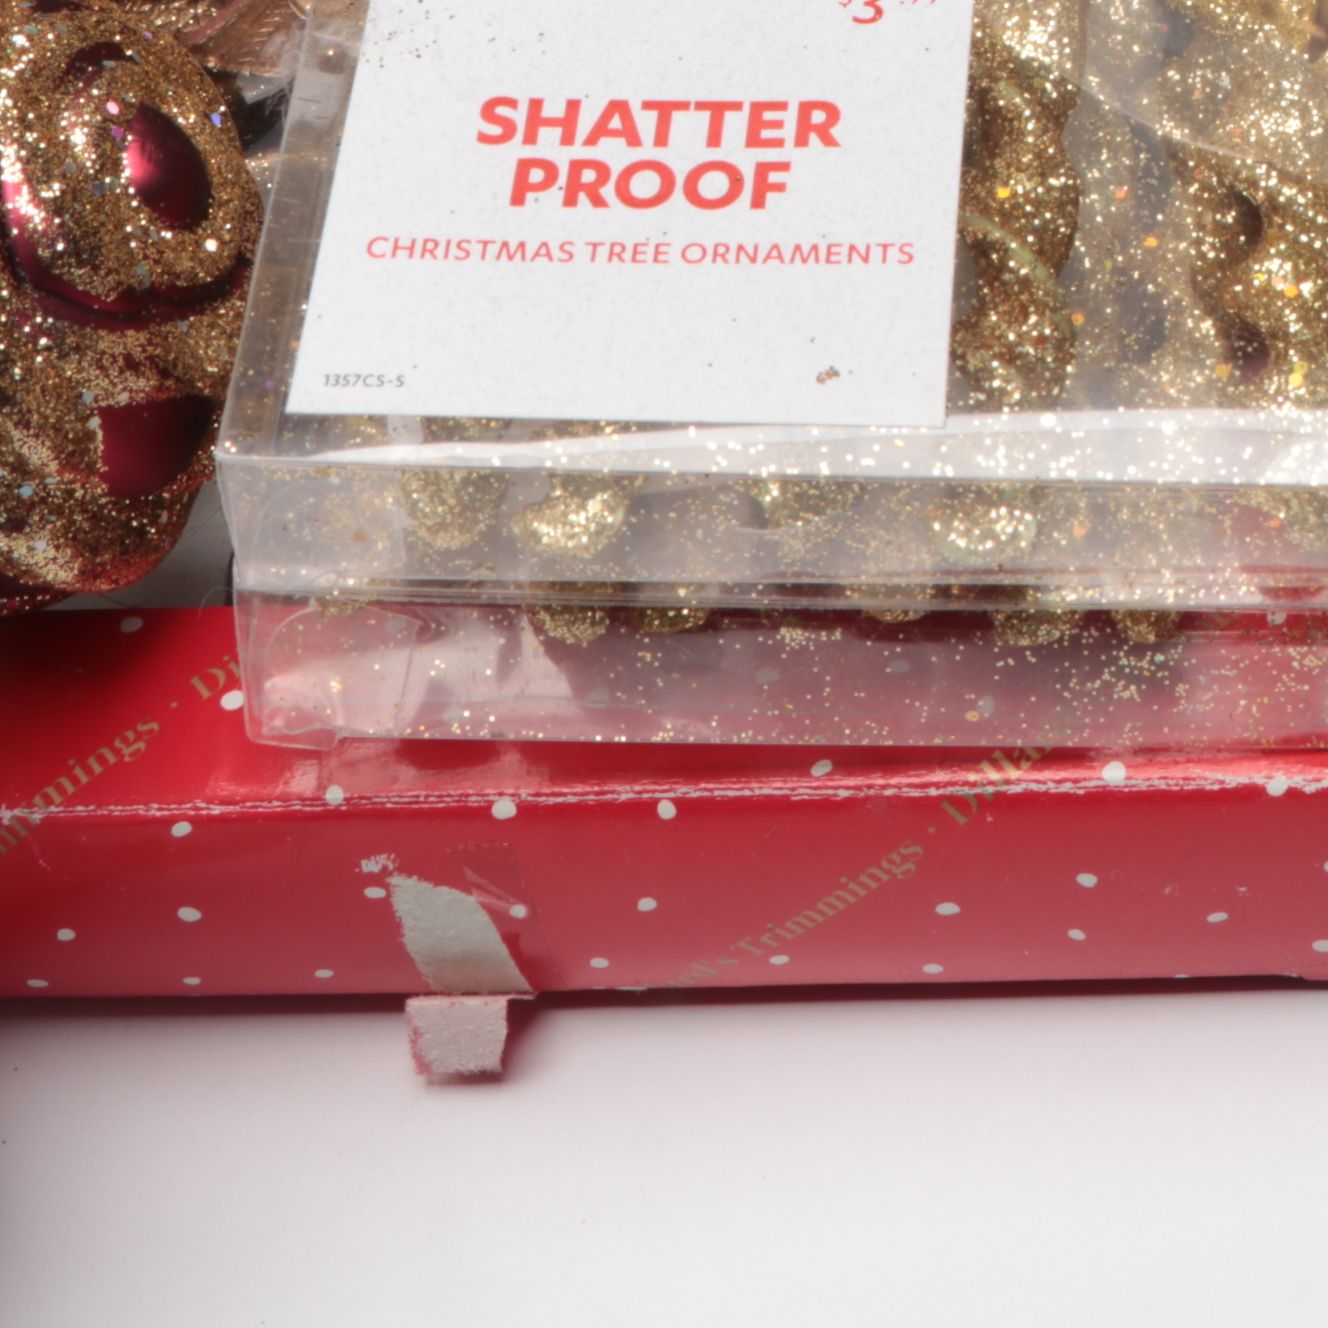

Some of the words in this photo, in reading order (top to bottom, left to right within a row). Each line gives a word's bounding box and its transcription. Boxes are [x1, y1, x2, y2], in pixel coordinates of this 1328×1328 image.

[475, 95, 843, 150] SHATTER
[508, 156, 793, 211] PROOF
[366, 235, 575, 264] CHRISTMAS
[585, 240, 671, 265] TREE
[679, 241, 916, 265] ORNAMENTS
[729, 838, 924, 957] Trimmings
